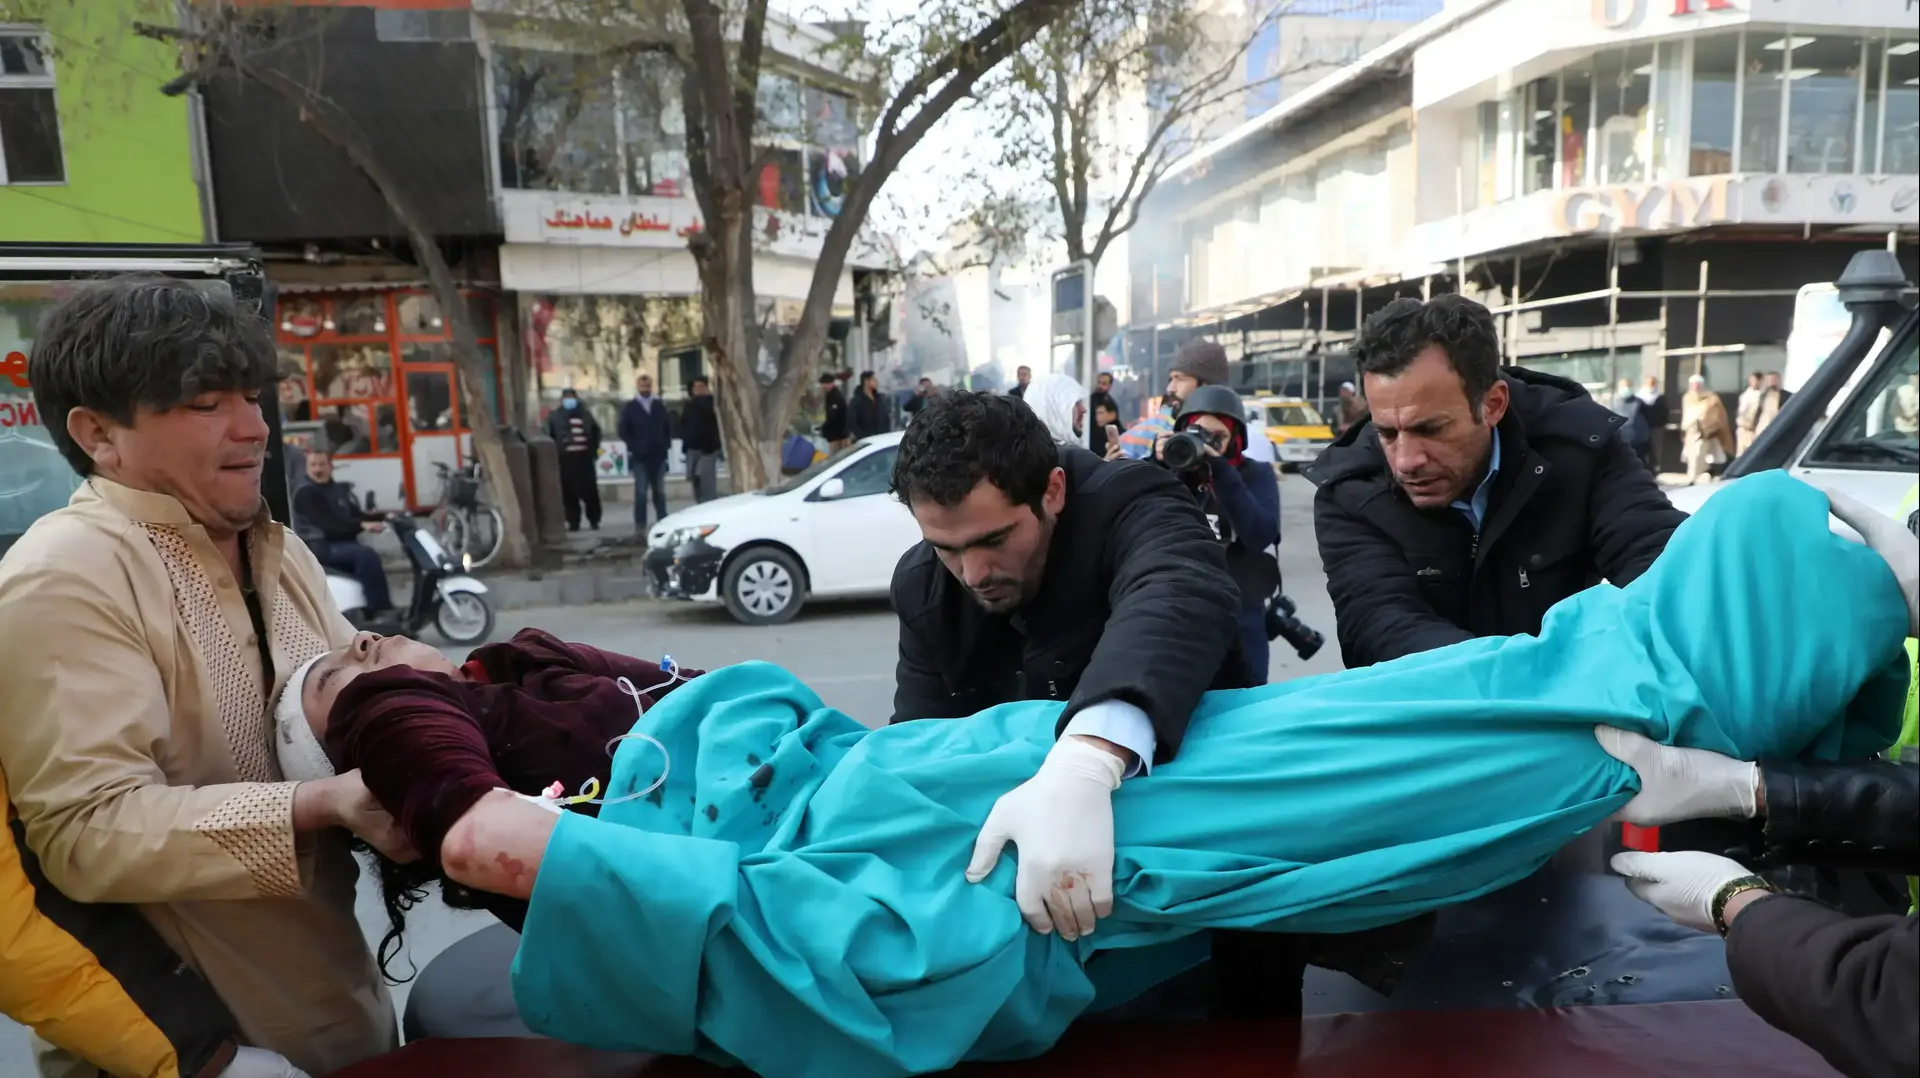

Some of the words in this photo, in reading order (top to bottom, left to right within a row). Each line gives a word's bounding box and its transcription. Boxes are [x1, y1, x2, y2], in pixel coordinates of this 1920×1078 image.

[1553, 179, 1728, 232] GYM
[545, 209, 613, 230] هماهنگ
[619, 211, 670, 237] سلطان
